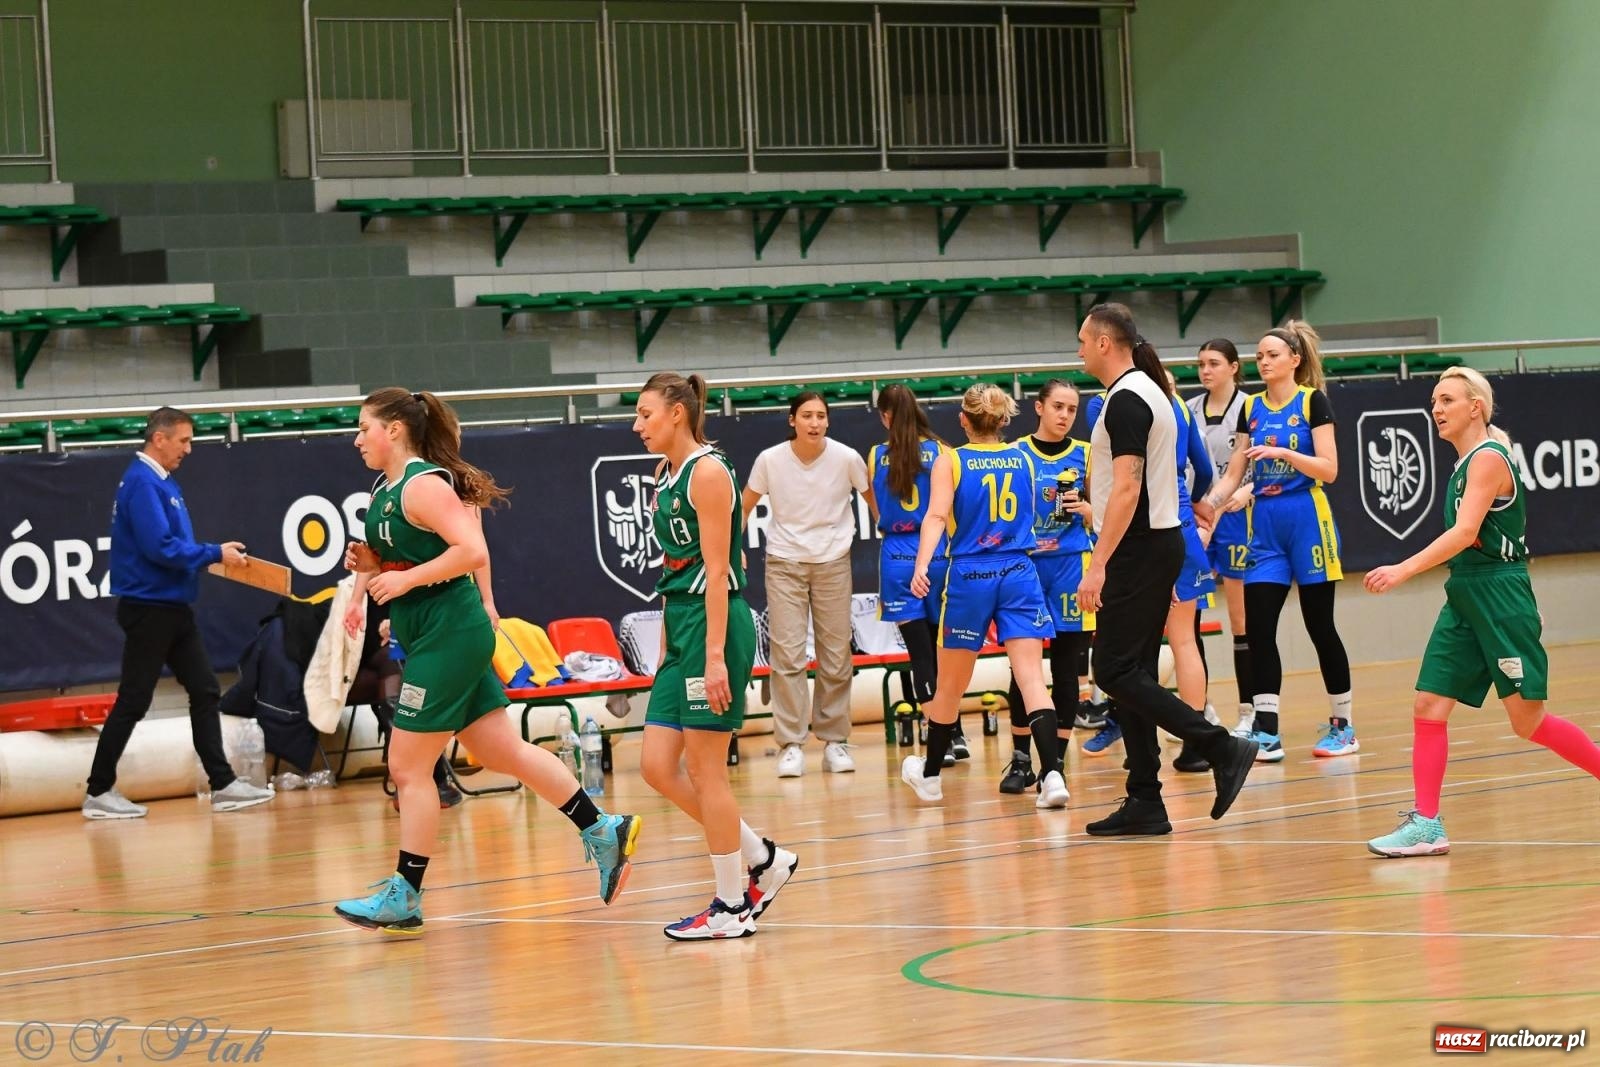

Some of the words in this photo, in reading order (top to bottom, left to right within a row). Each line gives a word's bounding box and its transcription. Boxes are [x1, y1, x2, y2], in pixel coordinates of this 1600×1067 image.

[1289, 433, 1298, 450] 8
[967, 457, 1023, 470] GŁUCHOŁAZY
[981, 472, 1018, 523] 16
[378, 520, 394, 548] 4
[669, 517, 692, 546] 13
[1227, 544, 1248, 568] 12
[1311, 544, 1324, 569] 8
[961, 570, 998, 581] schatt
[1059, 592, 1082, 618] 13
